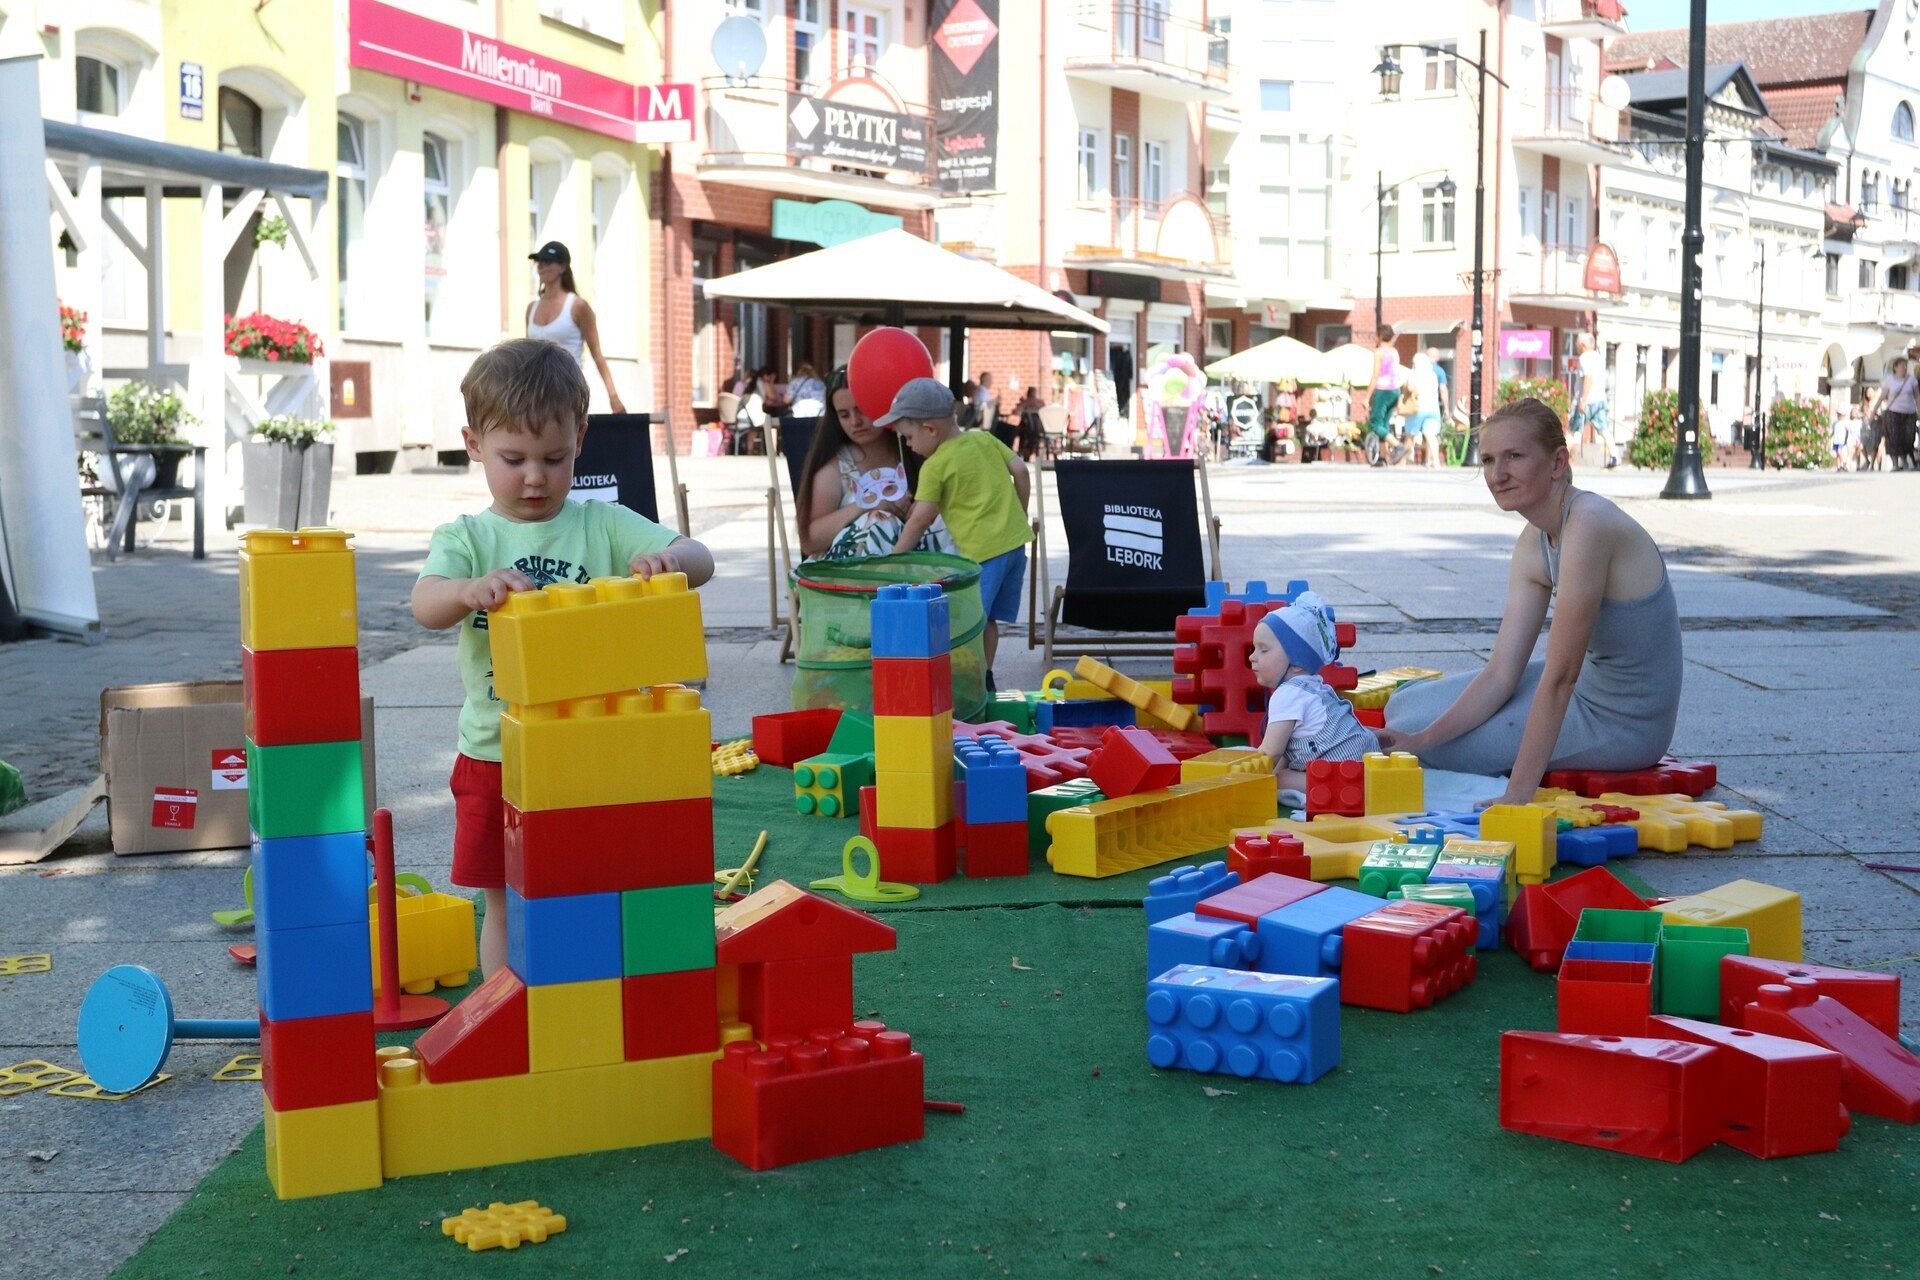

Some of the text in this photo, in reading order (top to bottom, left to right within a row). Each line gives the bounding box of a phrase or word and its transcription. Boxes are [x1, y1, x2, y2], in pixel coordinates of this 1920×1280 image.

[461, 30, 562, 98] Millennium
[183, 74, 201, 99] 16
[648, 86, 682, 120] M
[824, 107, 898, 147] PŁYTKI
[571, 474, 618, 487] LIOTEKA
[1104, 504, 1162, 519] BIBLIOTEKA
[510, 555, 572, 578] RUCK
[1107, 547, 1163, 570] LĘBORK
